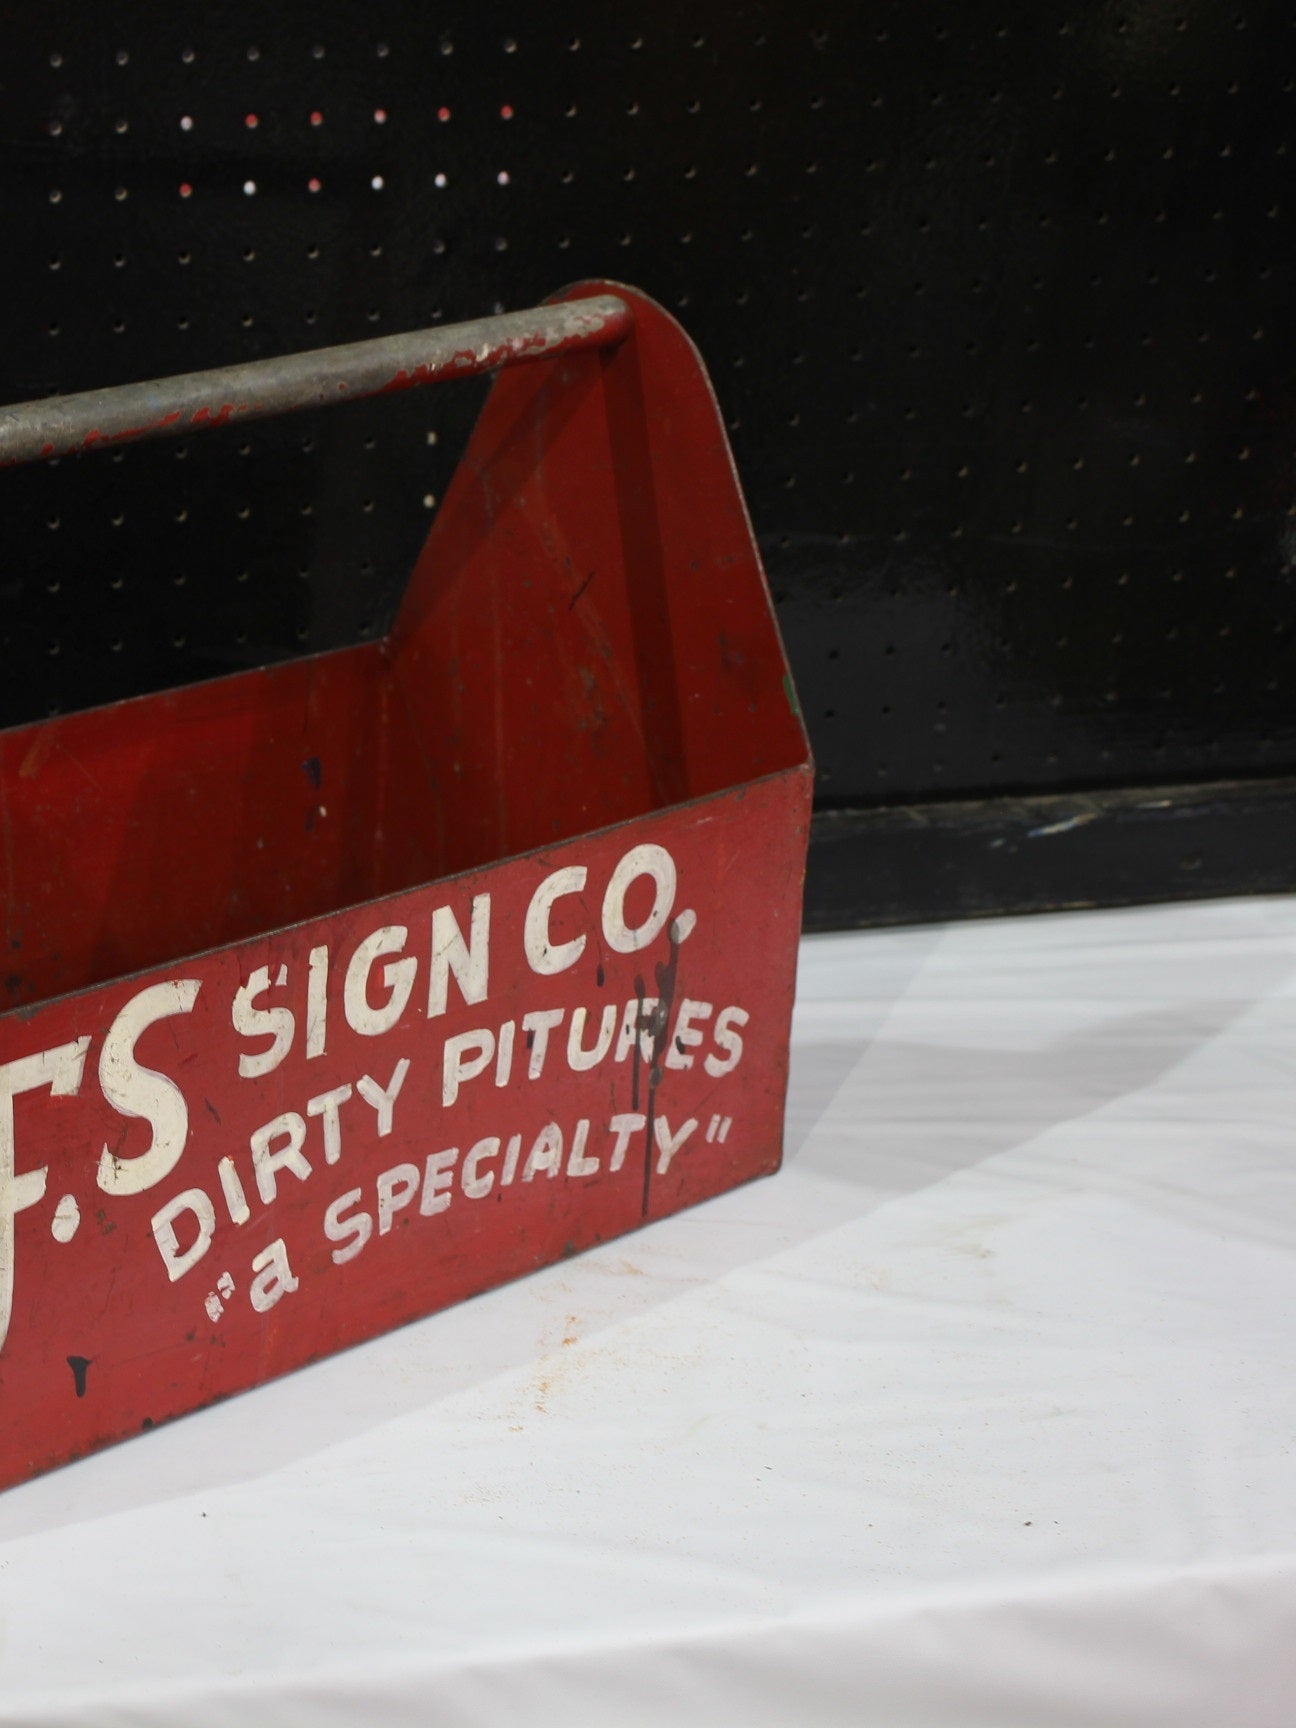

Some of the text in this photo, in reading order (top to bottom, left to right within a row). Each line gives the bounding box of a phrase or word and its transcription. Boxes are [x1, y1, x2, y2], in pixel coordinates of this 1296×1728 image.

[232, 893, 491, 1078] SIGN
[523, 843, 697, 976] CO.
[151, 998, 750, 1283] DIRTY PITURES
